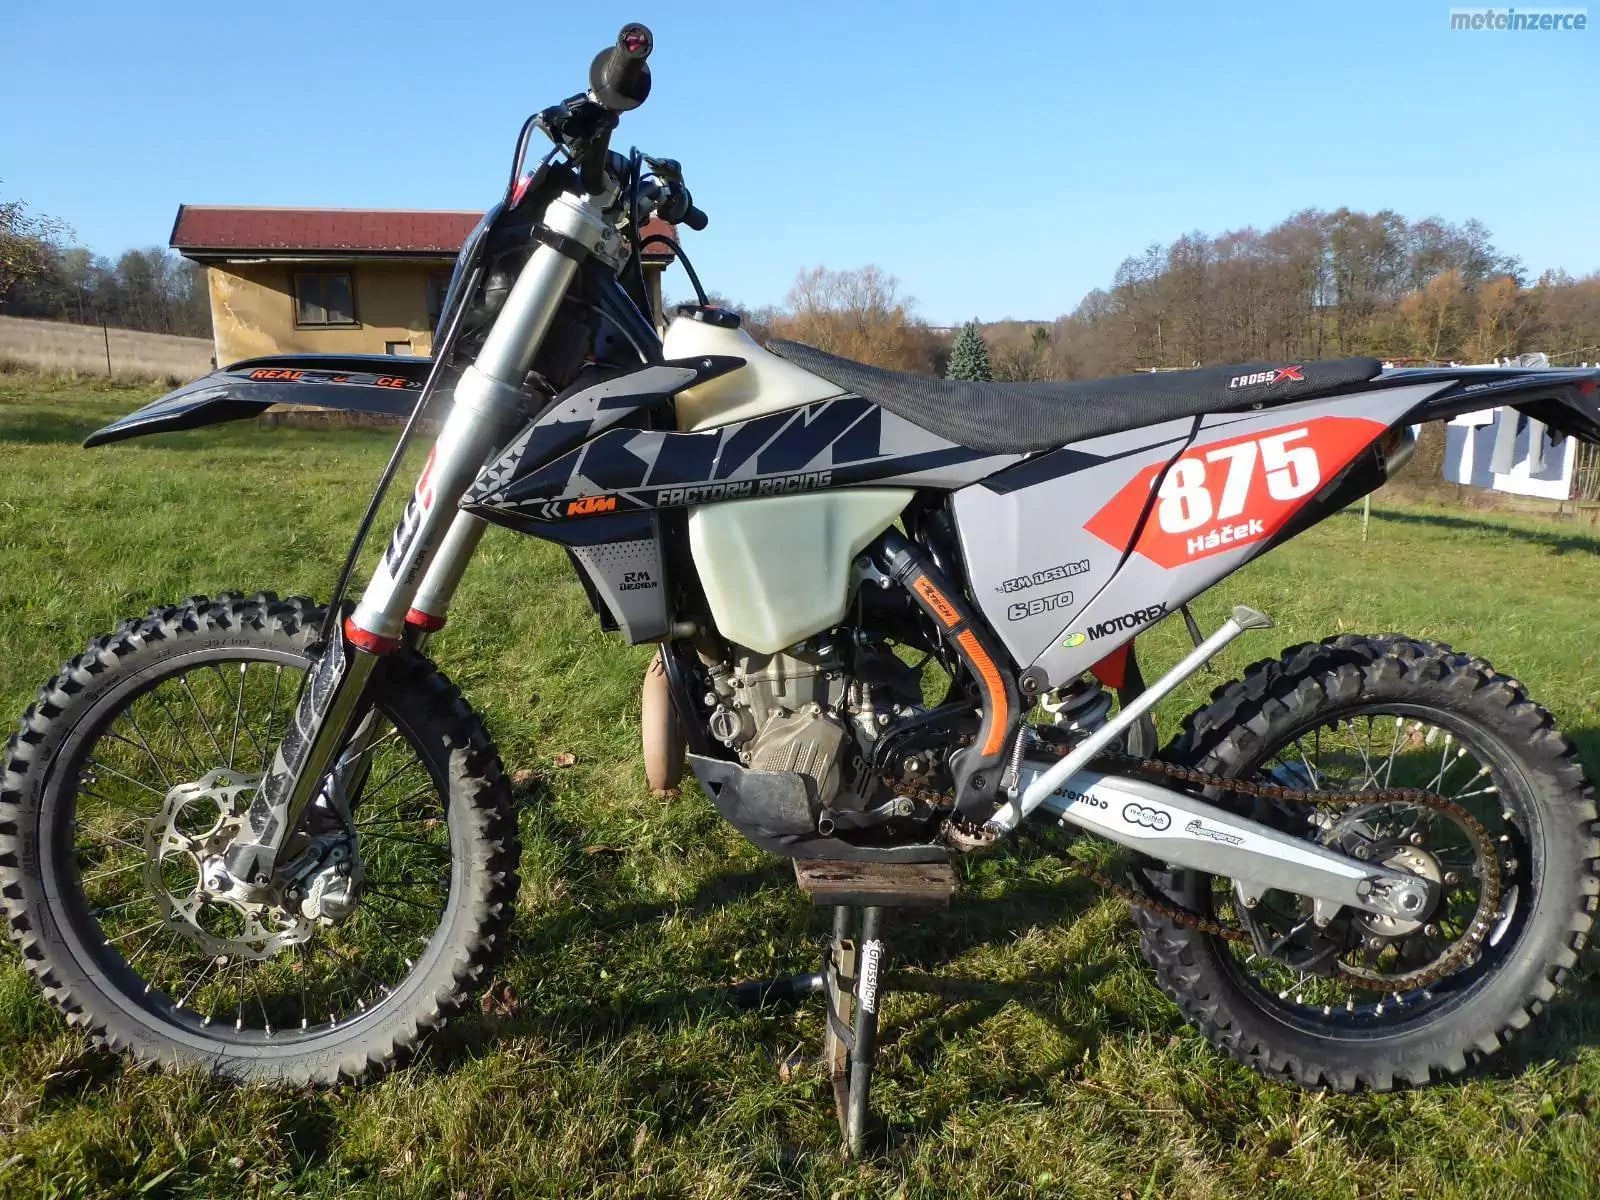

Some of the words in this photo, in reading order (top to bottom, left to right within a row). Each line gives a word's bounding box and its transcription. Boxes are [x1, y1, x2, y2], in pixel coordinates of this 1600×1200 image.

[657, 481, 753, 507] FACTORY
[756, 470, 832, 496] RACING
[1150, 427, 1320, 534] 875
[567, 496, 616, 516] KTM
[1186, 518, 1264, 555] Háček
[619, 581, 658, 591] DESIGN
[624, 571, 651, 582] RM
[1003, 575, 1033, 593] RM
[1033, 559, 1090, 585] DESIGN
[1087, 601, 1168, 641] MOTOREX
